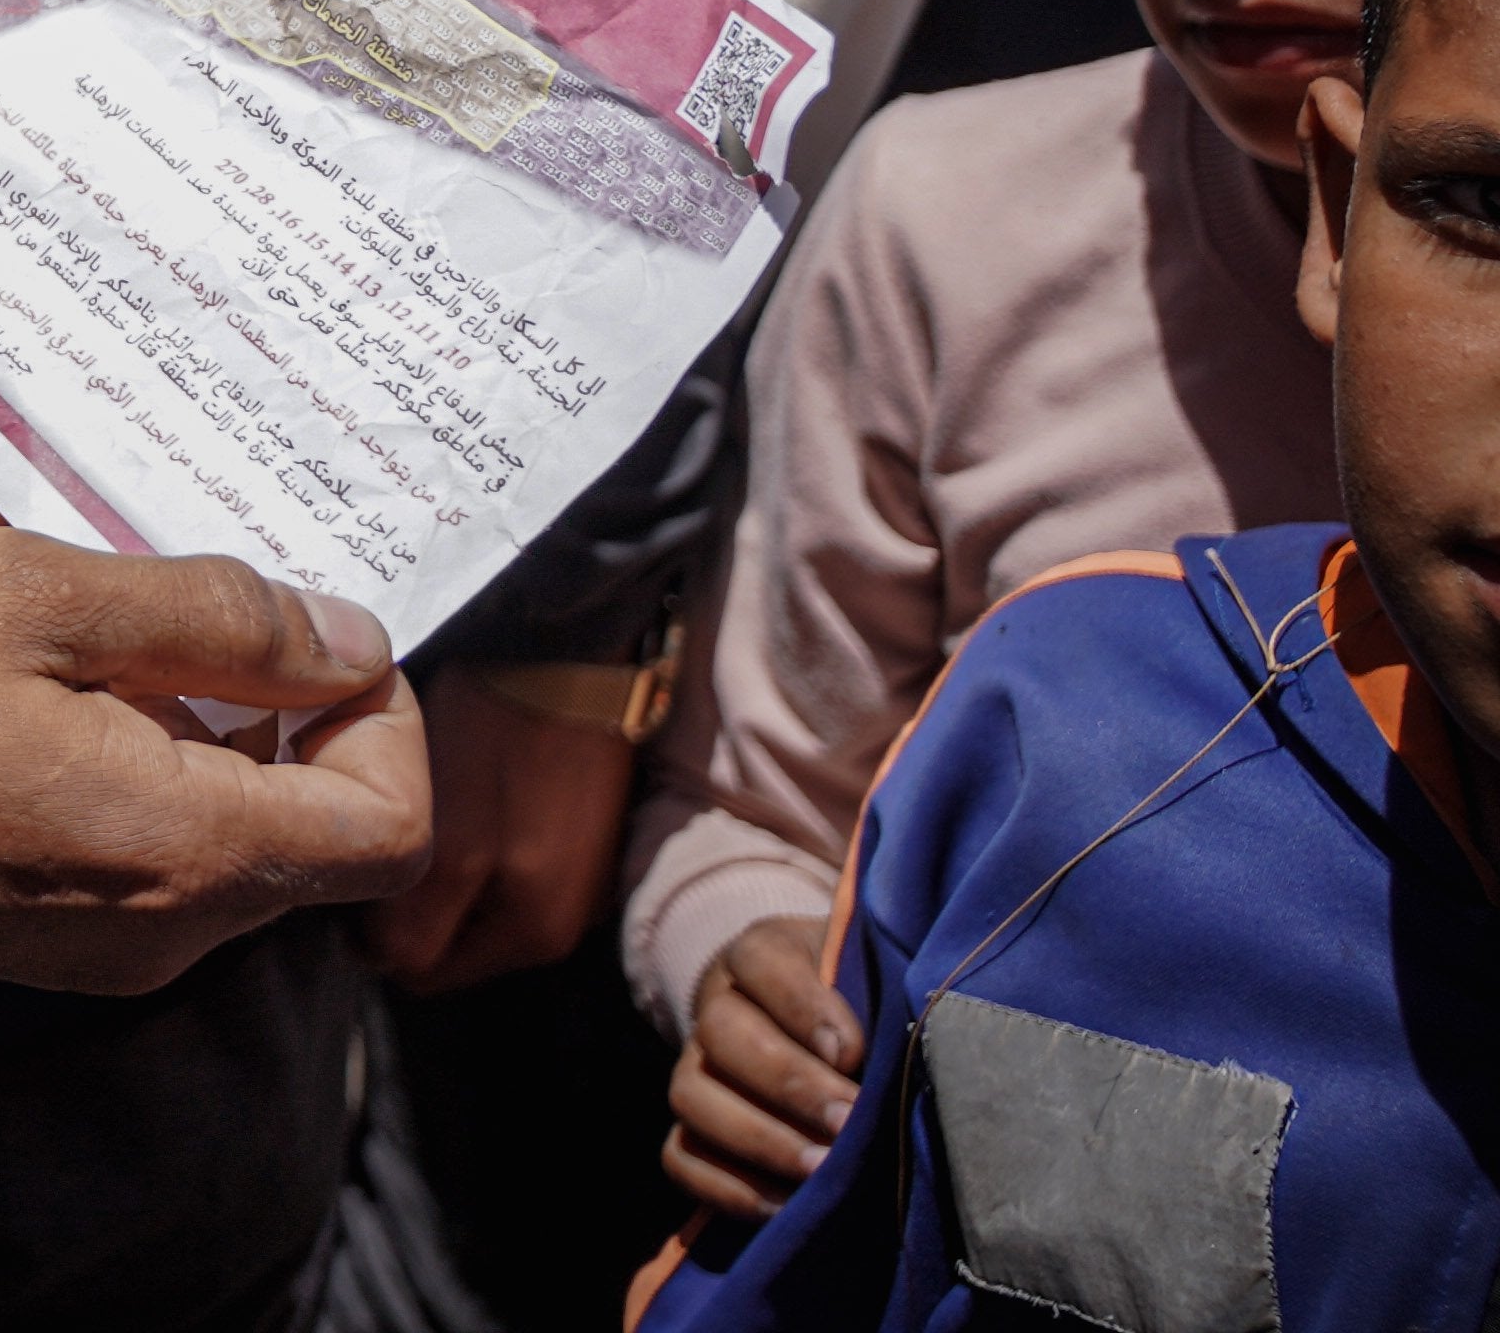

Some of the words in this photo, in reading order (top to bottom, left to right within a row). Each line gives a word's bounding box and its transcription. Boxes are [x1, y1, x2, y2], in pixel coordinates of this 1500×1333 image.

[364, 34, 413, 83] منطقة
[73, 72, 132, 122] الإرهابية
[322, 70, 356, 90] الدين
[352, 86, 384, 108] صلاح
[233, 92, 289, 145] وبالأحياء
[123, 118, 193, 176] المنظمات
[290, 136, 344, 183] الشوكة
[56, 155, 92, 196] وحياة
[184, 176, 213, 196] ضد
[213, 157, 250, 185] 270
[5, 188, 61, 231] الفوري
[90, 191, 126, 223] حياته
[210, 192, 259, 235] شديدة
[338, 175, 377, 216] بلدية
[14, 231, 39, 253] من
[122, 226, 168, 267] يعرض
[255, 230, 288, 266] بقوة
[376, 205, 416, 251] منطقة
[34, 243, 90, 294] امتنعوا
[53, 228, 102, 278] بالإخلاء
[411, 240, 439, 263] في
[95, 277, 158, 329] يناشدكم
[167, 255, 230, 313] الإرهابية
[265, 285, 301, 309] حتى
[283, 261, 328, 304] يعمل
[431, 257, 501, 314] والنازحين
[296, 309, 339, 336] فعل
[327, 297, 366, 330] سوف
[457, 314, 498, 346] زراع
[498, 308, 560, 357] السكان
[43, 331, 98, 372] الشرقي
[123, 331, 163, 359] قتال
[146, 325, 224, 380] الإسرائيلي
[224, 310, 295, 374] المنظمات
[333, 331, 370, 368] مثلما
[495, 337, 525, 366] تبة
[156, 355, 201, 402] منطقة
[283, 368, 311, 390] من
[550, 354, 586, 376] كل
[84, 373, 137, 410] الأمني
[209, 378, 266, 419] الدفاع
[574, 375, 608, 397] الى
[200, 389, 237, 432] زالت
[308, 386, 360, 438] بالقرب
[425, 384, 488, 431] الدفاع
[123, 409, 181, 450] الجدار
[230, 423, 248, 444] ما
[254, 419, 296, 454] جيش
[430, 423, 486, 473] مناطق
[167, 447, 193, 467] من
[245, 438, 278, 468] غزة
[357, 433, 412, 487] يتواجد
[477, 432, 526, 472] جيش
[191, 466, 255, 520] الاقتراب
[273, 465, 315, 508] مدينة
[290, 456, 359, 510] سلامتكم
[408, 482, 437, 505] من
[480, 472, 511, 495] في
[311, 506, 343, 526] ان
[353, 510, 399, 542] اجل
[433, 505, 471, 527] كل
[242, 523, 292, 564] بعدم
[329, 532, 400, 583] نحذركم
[387, 540, 418, 565] من
[285, 567, 339, 591] ركم
